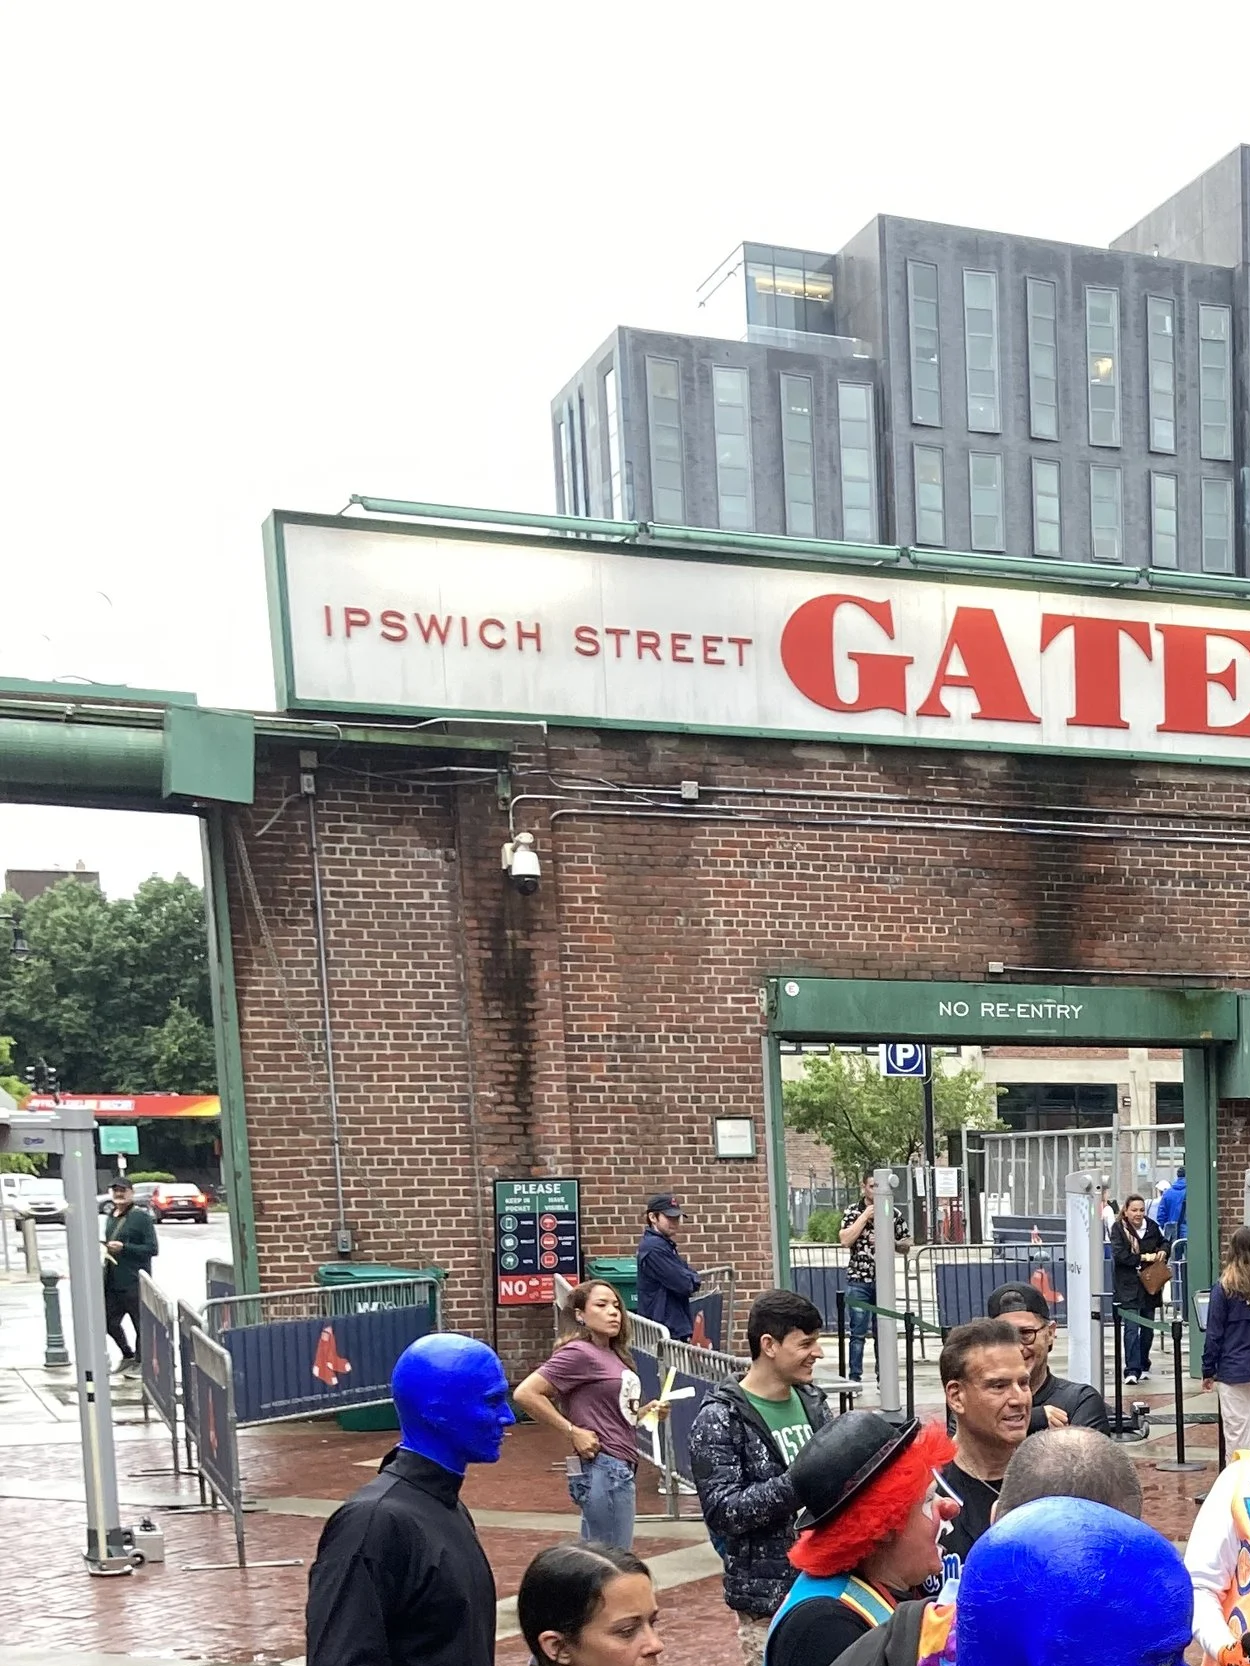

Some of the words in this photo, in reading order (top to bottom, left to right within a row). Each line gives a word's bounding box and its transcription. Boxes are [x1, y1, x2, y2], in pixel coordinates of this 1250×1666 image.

[323, 606, 542, 653] IPSWICH
[574, 626, 753, 668] STREET
[939, 1001, 970, 1017] NO
[980, 1002, 1083, 1020] RE-ENTRY
[896, 1044, 914, 1066] P
[513, 1183, 562, 1195] PLEASE
[501, 1280, 527, 1296] NO
